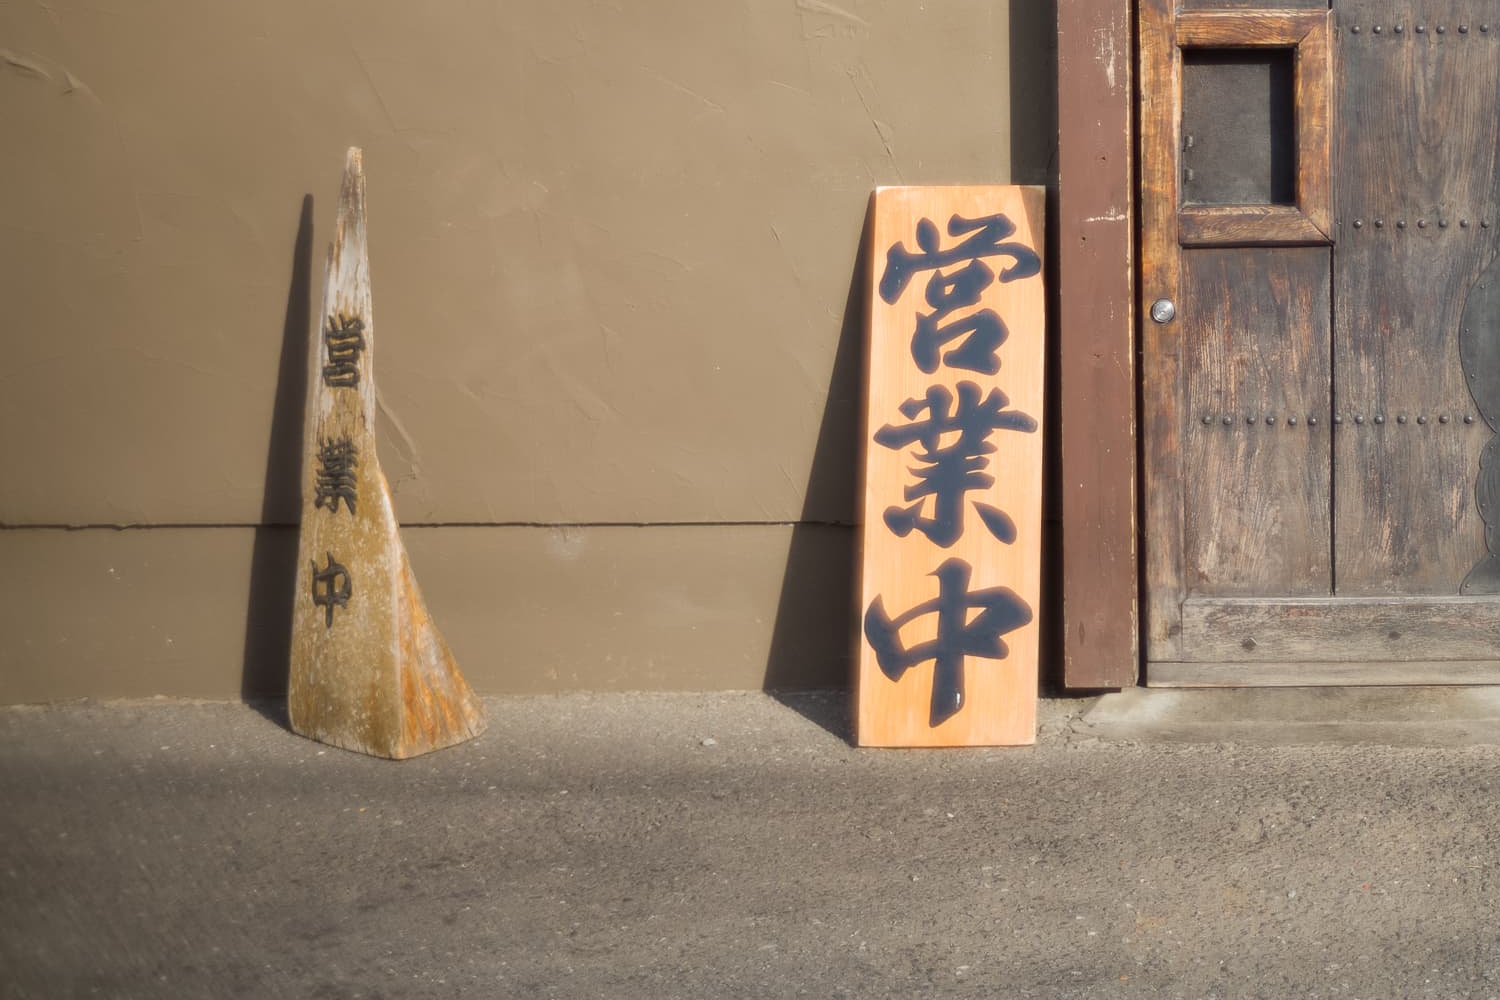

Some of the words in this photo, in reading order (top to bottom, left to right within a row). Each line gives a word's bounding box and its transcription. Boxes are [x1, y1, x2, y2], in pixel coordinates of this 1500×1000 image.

[310, 313, 366, 628] 営業中
[863, 212, 1042, 728] 営業中
